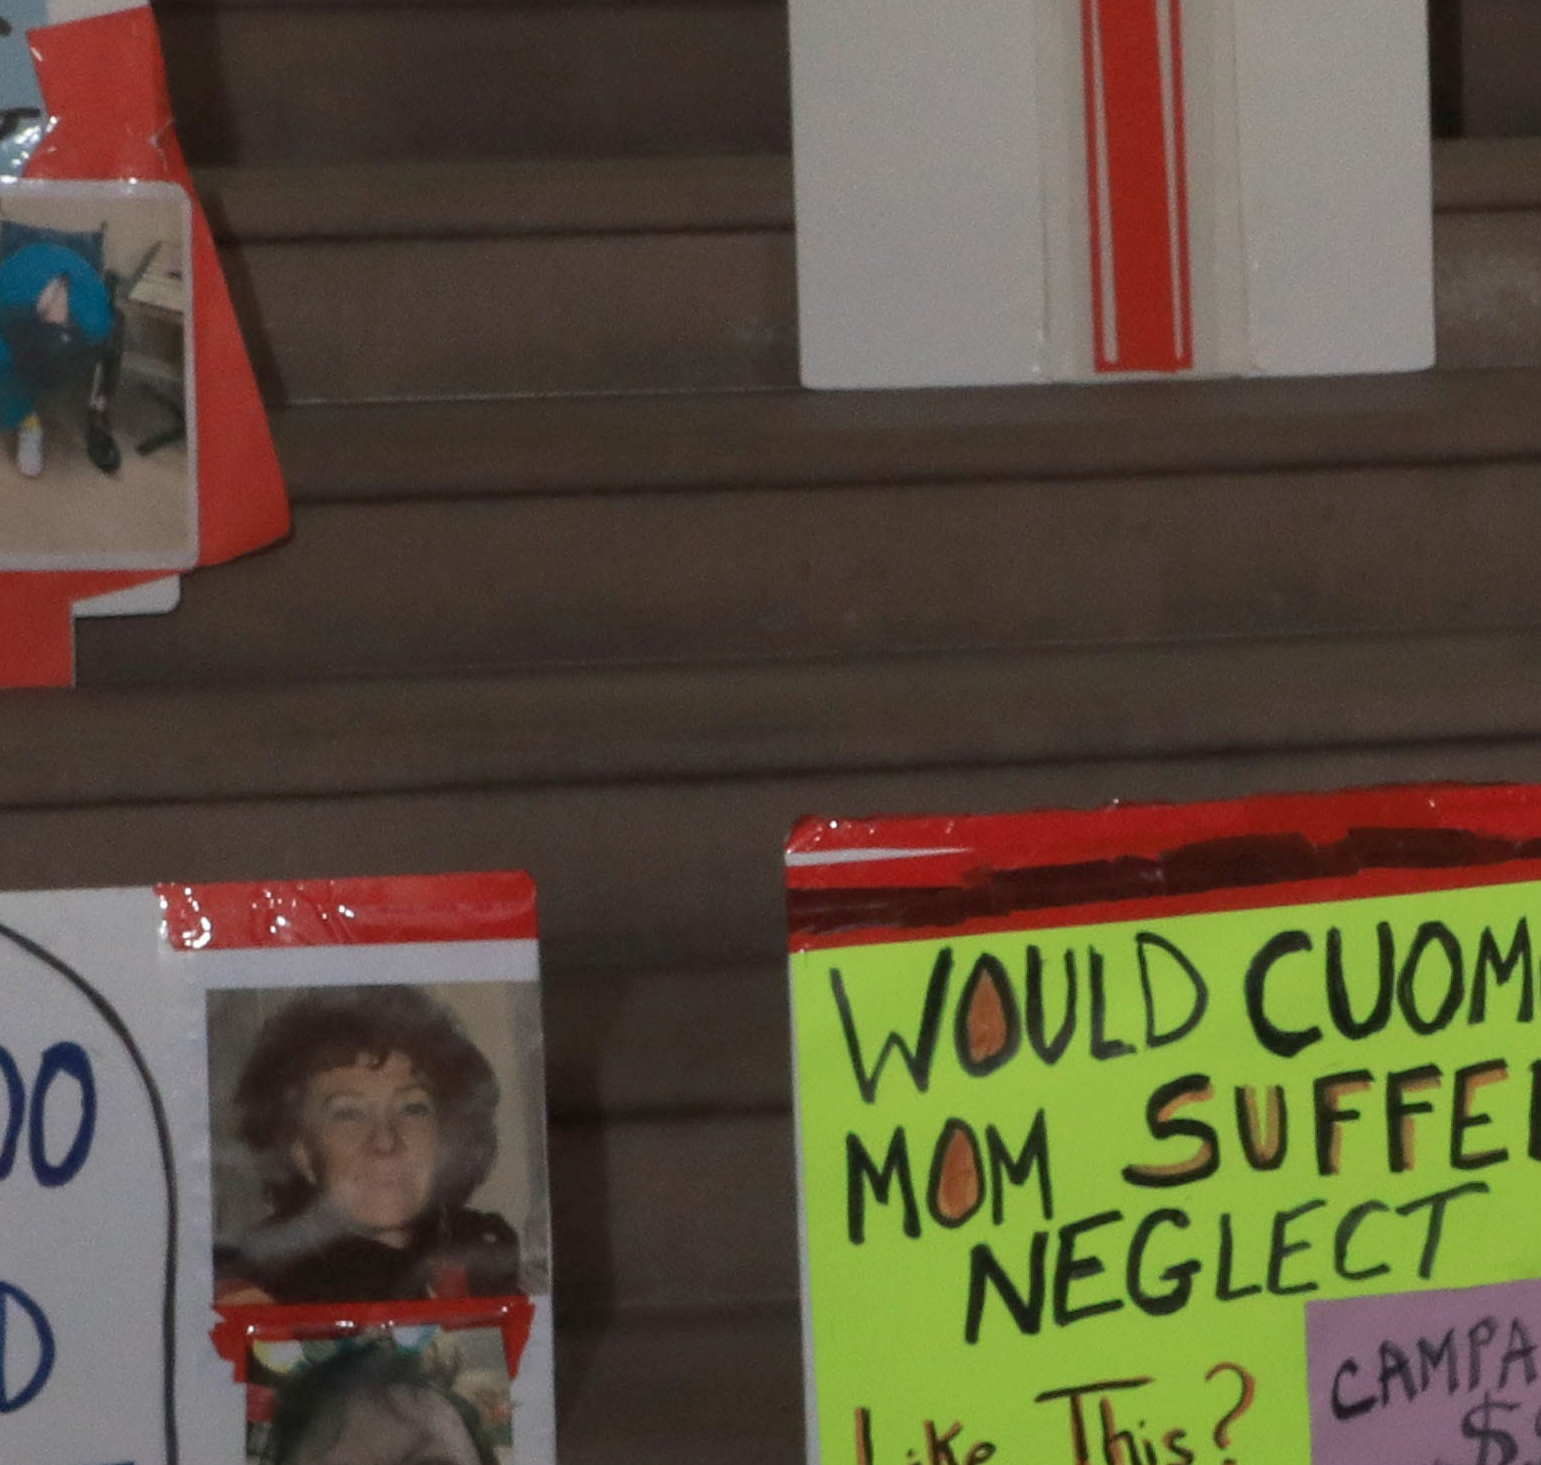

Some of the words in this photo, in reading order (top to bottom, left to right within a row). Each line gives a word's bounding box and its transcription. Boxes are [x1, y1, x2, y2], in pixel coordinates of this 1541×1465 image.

[830, 931, 1209, 1103] WOULD
[845, 1108, 1054, 1244] MOM
[965, 1182, 1490, 1344] NEGLECT
